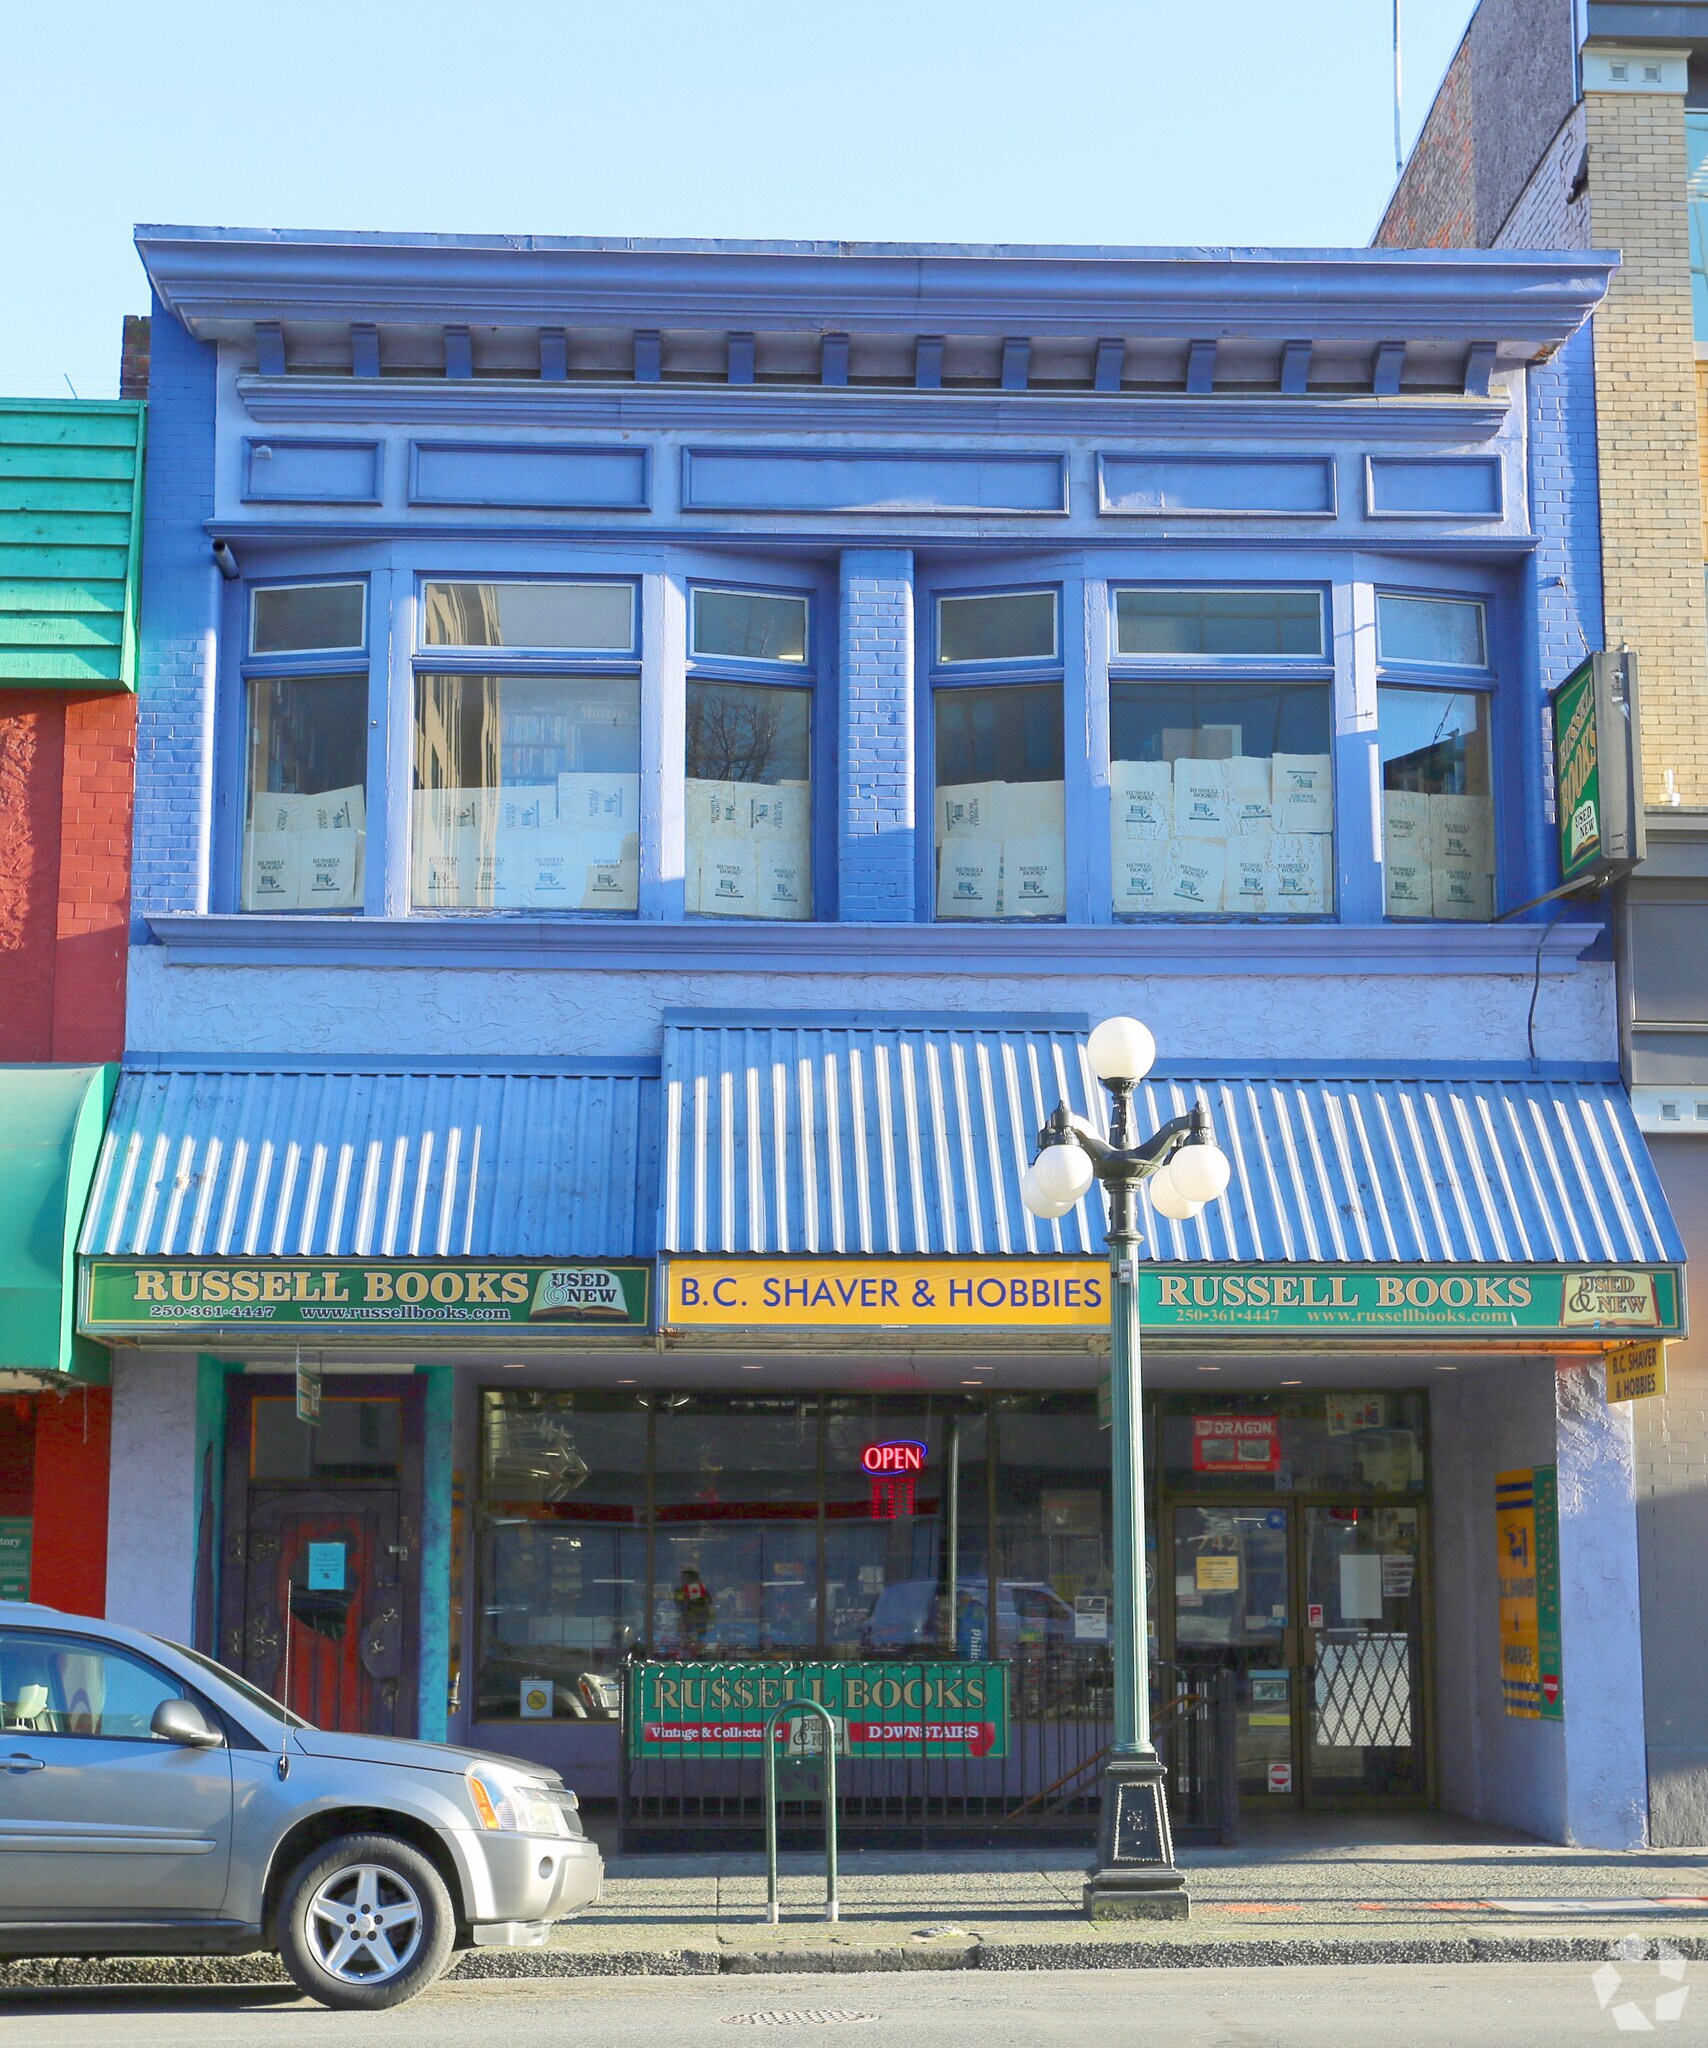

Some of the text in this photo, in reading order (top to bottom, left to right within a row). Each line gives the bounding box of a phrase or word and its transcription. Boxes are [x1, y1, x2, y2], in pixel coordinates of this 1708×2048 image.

[1561, 712, 1597, 834] BOOKS
[1575, 805, 1592, 828] USED
[1580, 817, 1594, 839] NEW
[134, 1270, 529, 1304] RUSSELL BOOKS
[551, 1272, 610, 1287] USED
[1579, 1275, 1634, 1293] USED
[543, 1279, 617, 1306] & NEW
[681, 1277, 1102, 1308] B.C. SHAVER & HOBBIES
[1157, 1275, 1533, 1309] RUSSELL BOOKS
[1569, 1282, 1647, 1315] & NEW
[300, 1304, 511, 1322] www.russellbooks.com
[1306, 1310, 1508, 1326] www.russellbooks.com
[1612, 1347, 1657, 1376] B.C. SHAVER
[1616, 1373, 1656, 1400] & HOBBIES
[1214, 1422, 1272, 1434] DRAGON
[864, 1447, 920, 1470] OPEN
[1198, 1535, 1239, 1551] 742
[651, 1678, 987, 1709] RUSSELL BOOKS
[651, 1727, 783, 1740] Vintage & Collectae
[868, 1725, 979, 1738] DOWNSTAIRS
